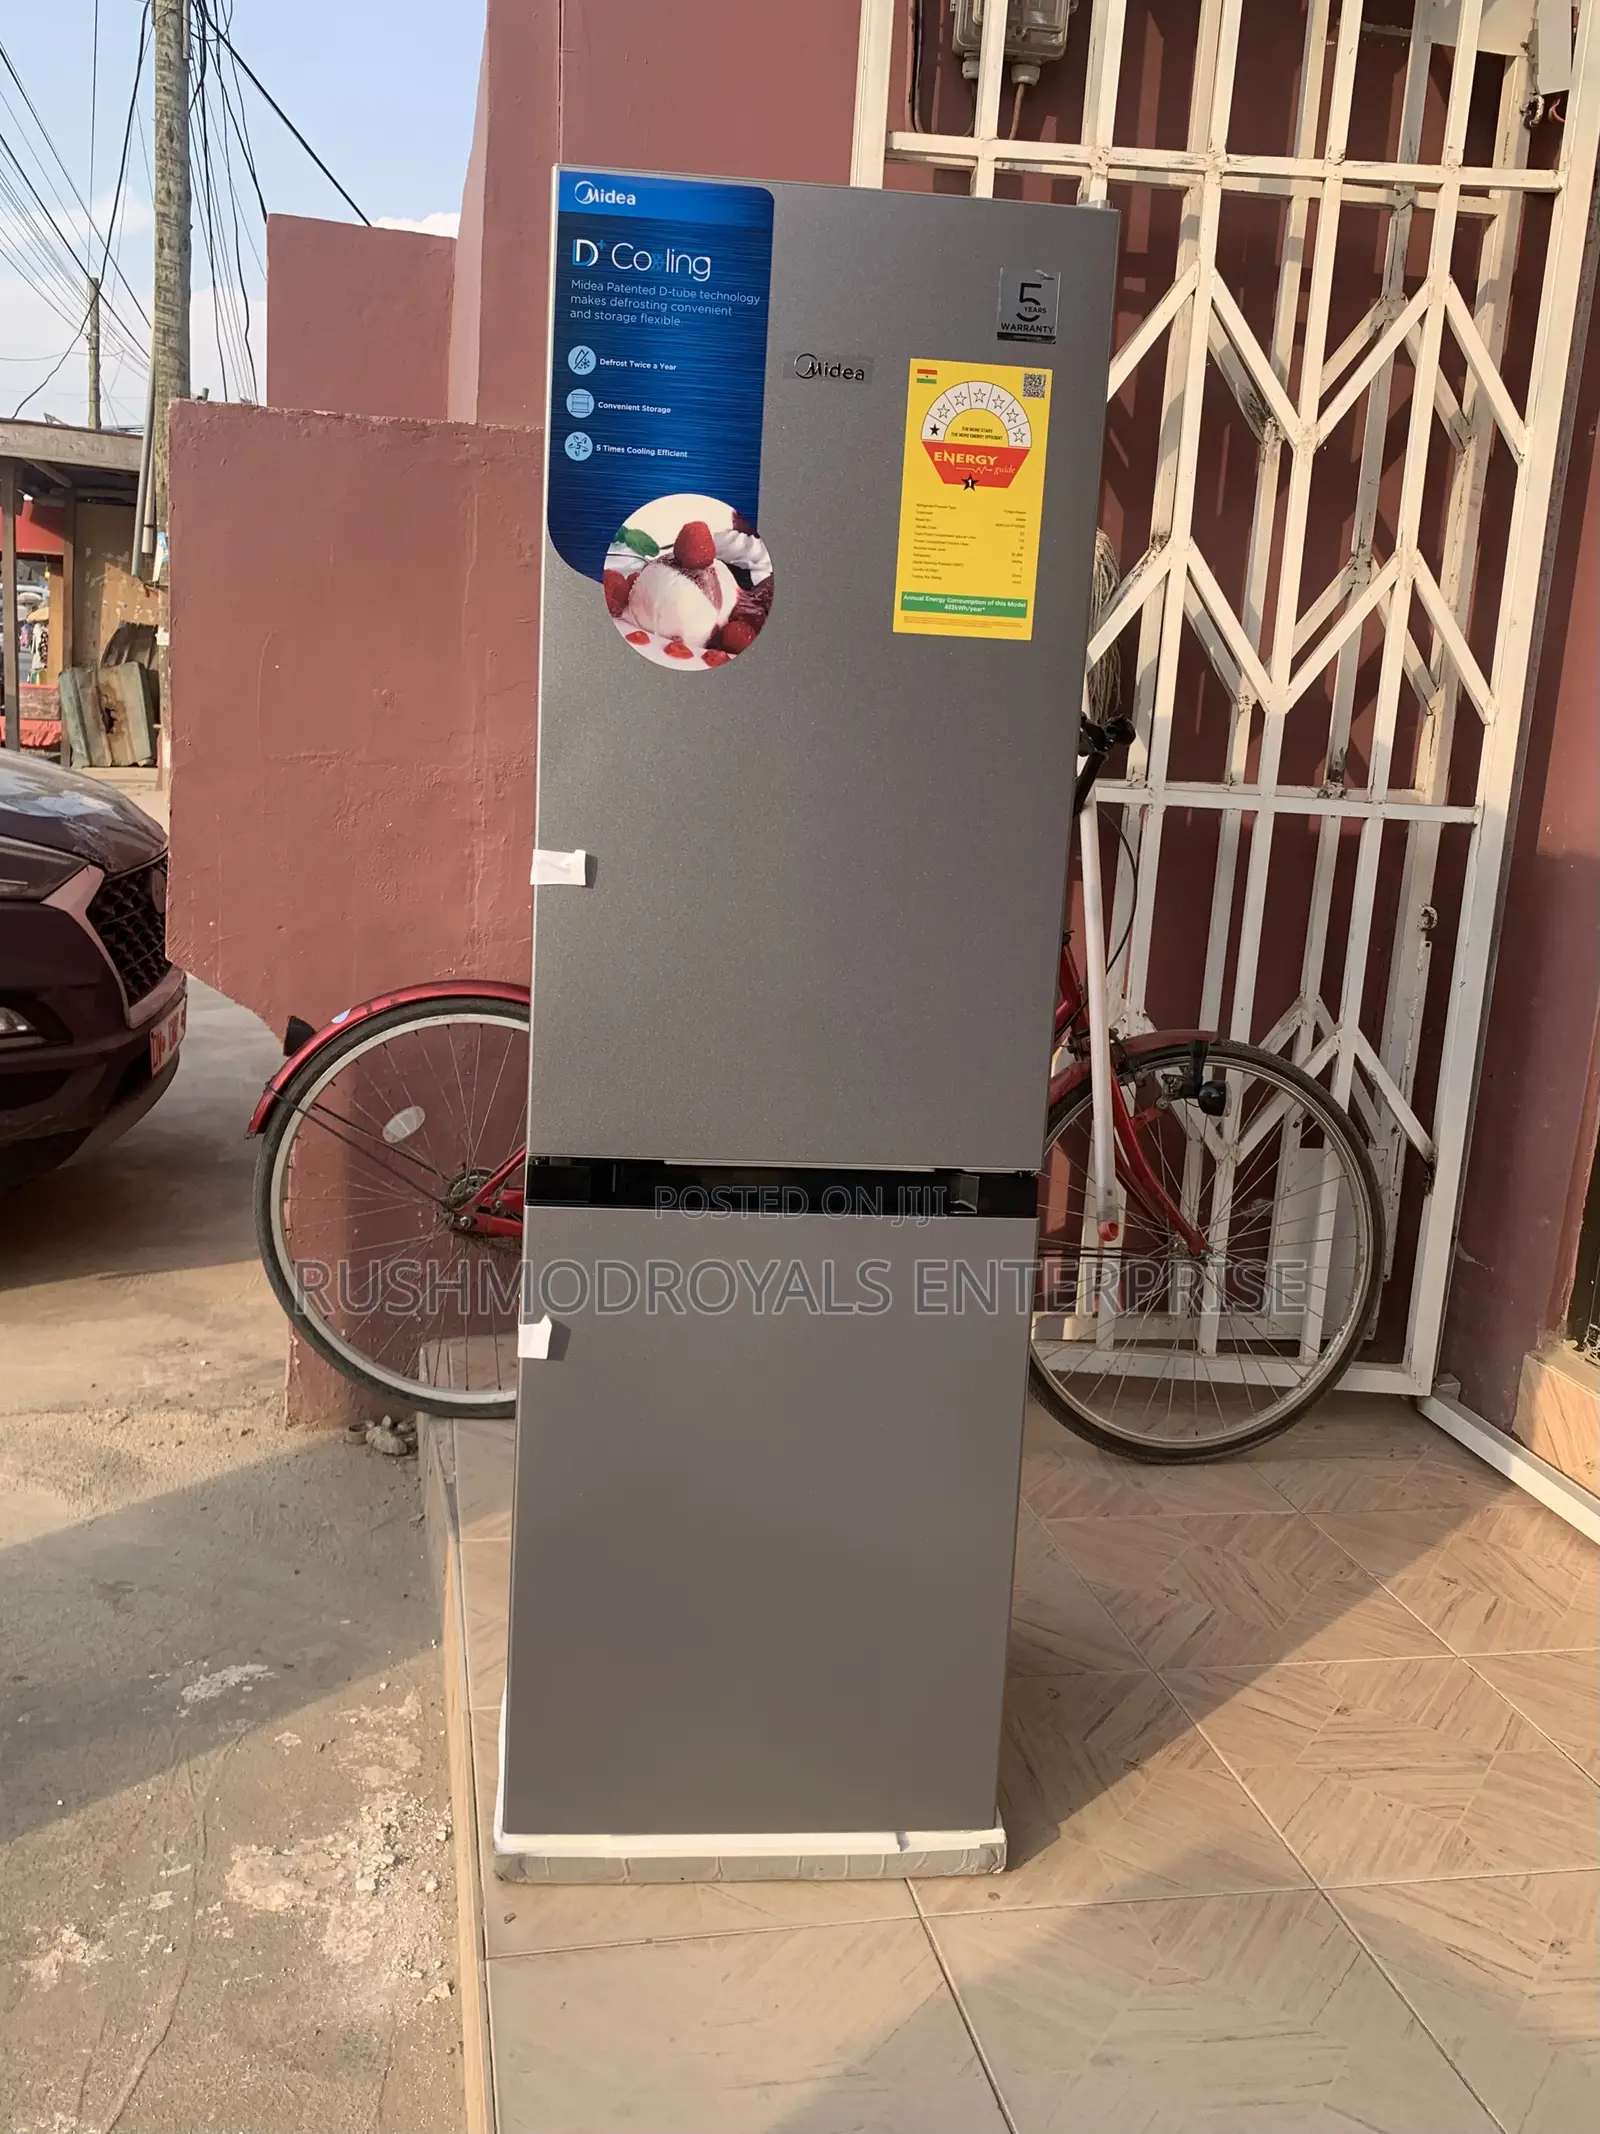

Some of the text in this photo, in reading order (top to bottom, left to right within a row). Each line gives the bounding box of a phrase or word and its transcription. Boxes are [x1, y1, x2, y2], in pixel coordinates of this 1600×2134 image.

[574, 180, 636, 206] Midea
[571, 279, 760, 306] Midea Patented D-tube technology
[570, 294, 733, 317] makes defrosting convenient
[1016, 282, 1043, 323] 5
[1023, 305, 1048, 315] YEARS
[569, 308, 683, 327] and storage flexible.
[1000, 322, 1055, 334] WARRANTY
[599, 358, 628, 368] Defrost
[629, 360, 652, 370] Twice
[659, 362, 677, 372] Year
[793, 353, 865, 382] Midea
[597, 401, 672, 415] Convenient Storage
[596, 443, 688, 459] 5 Times Cooling Efficient
[934, 449, 998, 467] ENERGY
[993, 464, 1016, 476] guide
[903, 594, 1027, 609] Annual Energy Consumption of this Model
